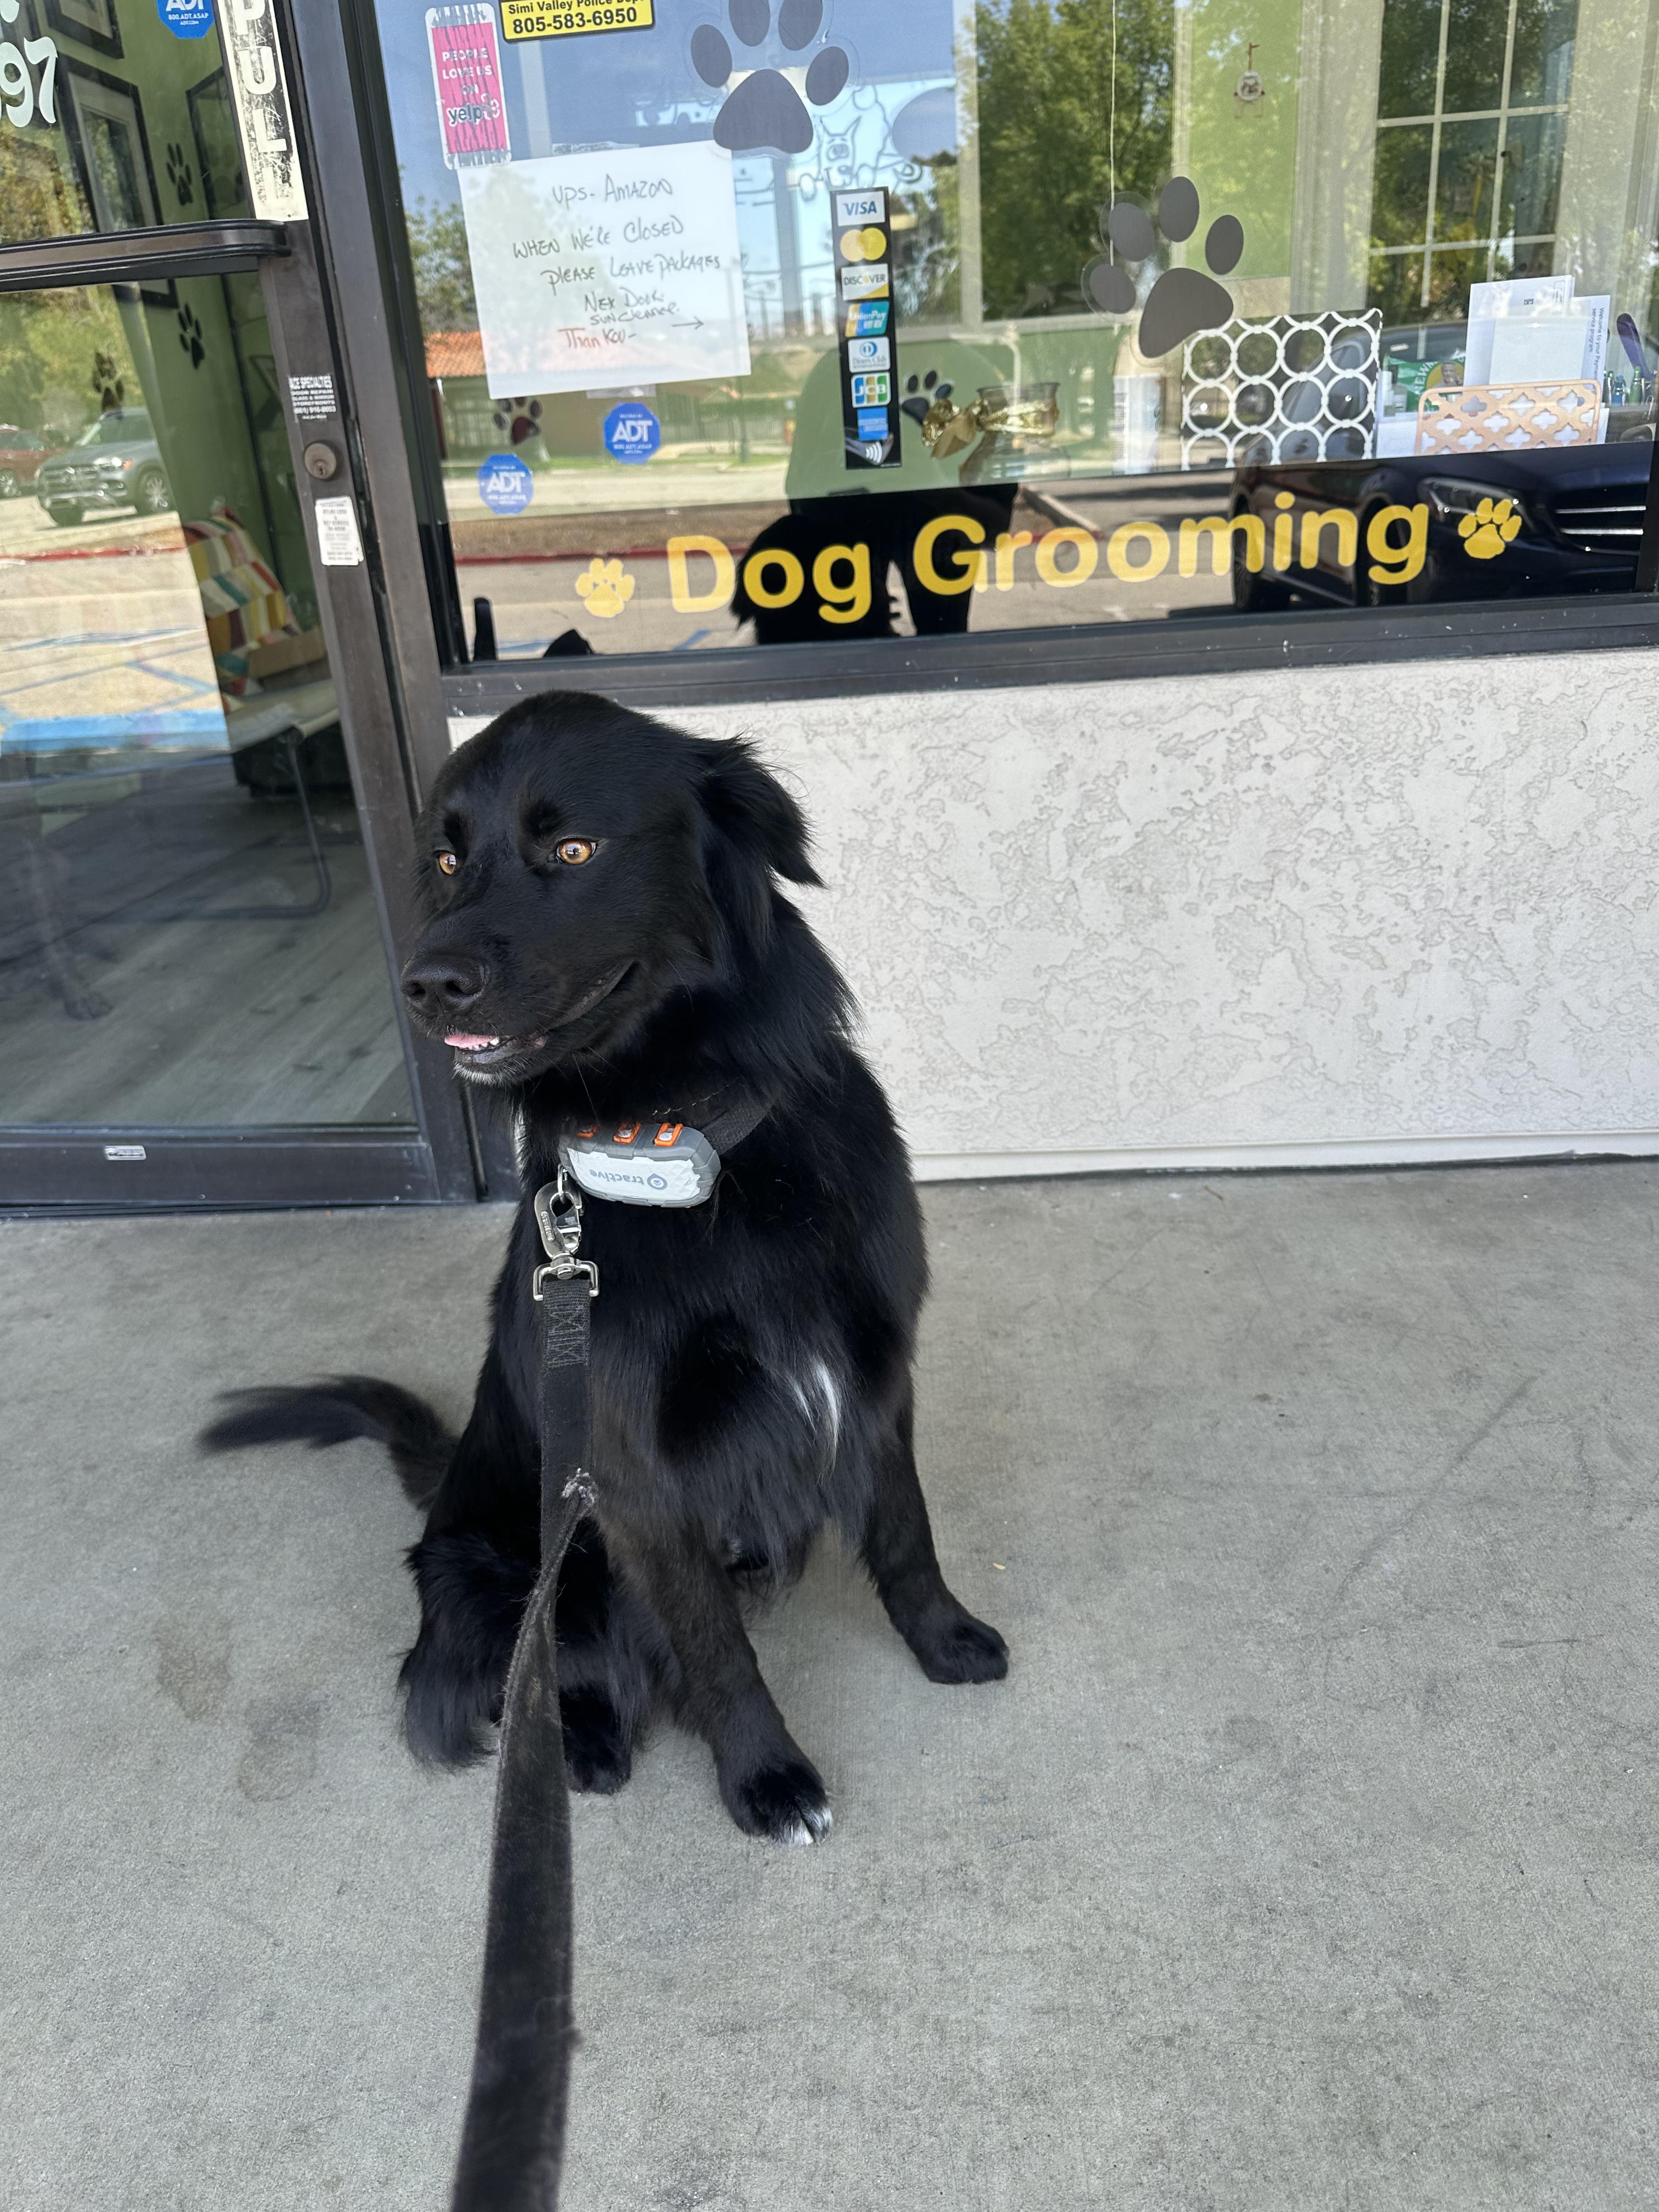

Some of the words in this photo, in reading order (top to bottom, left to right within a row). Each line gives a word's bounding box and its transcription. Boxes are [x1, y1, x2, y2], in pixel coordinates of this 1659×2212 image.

[509, 2, 533, 14] Simi
[537, 0, 573, 12] Valley
[512, 7, 637, 34] 805-583-6950
[442, 48, 488, 61] PEOPLE
[442, 66, 474, 79] LOVE
[476, 65, 493, 76] US
[0, 36, 58, 128] 97
[461, 83, 479, 95] ON
[447, 103, 483, 126] yelp
[843, 201, 878, 216] VISA
[512, 238, 561, 259] WHEN
[855, 385, 887, 396] JCB
[612, 420, 653, 442] ADT
[487, 472, 526, 493] ADT
[667, 534, 871, 624] Dog
[912, 492, 1429, 595] Grooming
[590, 1169, 645, 1186] tractive
